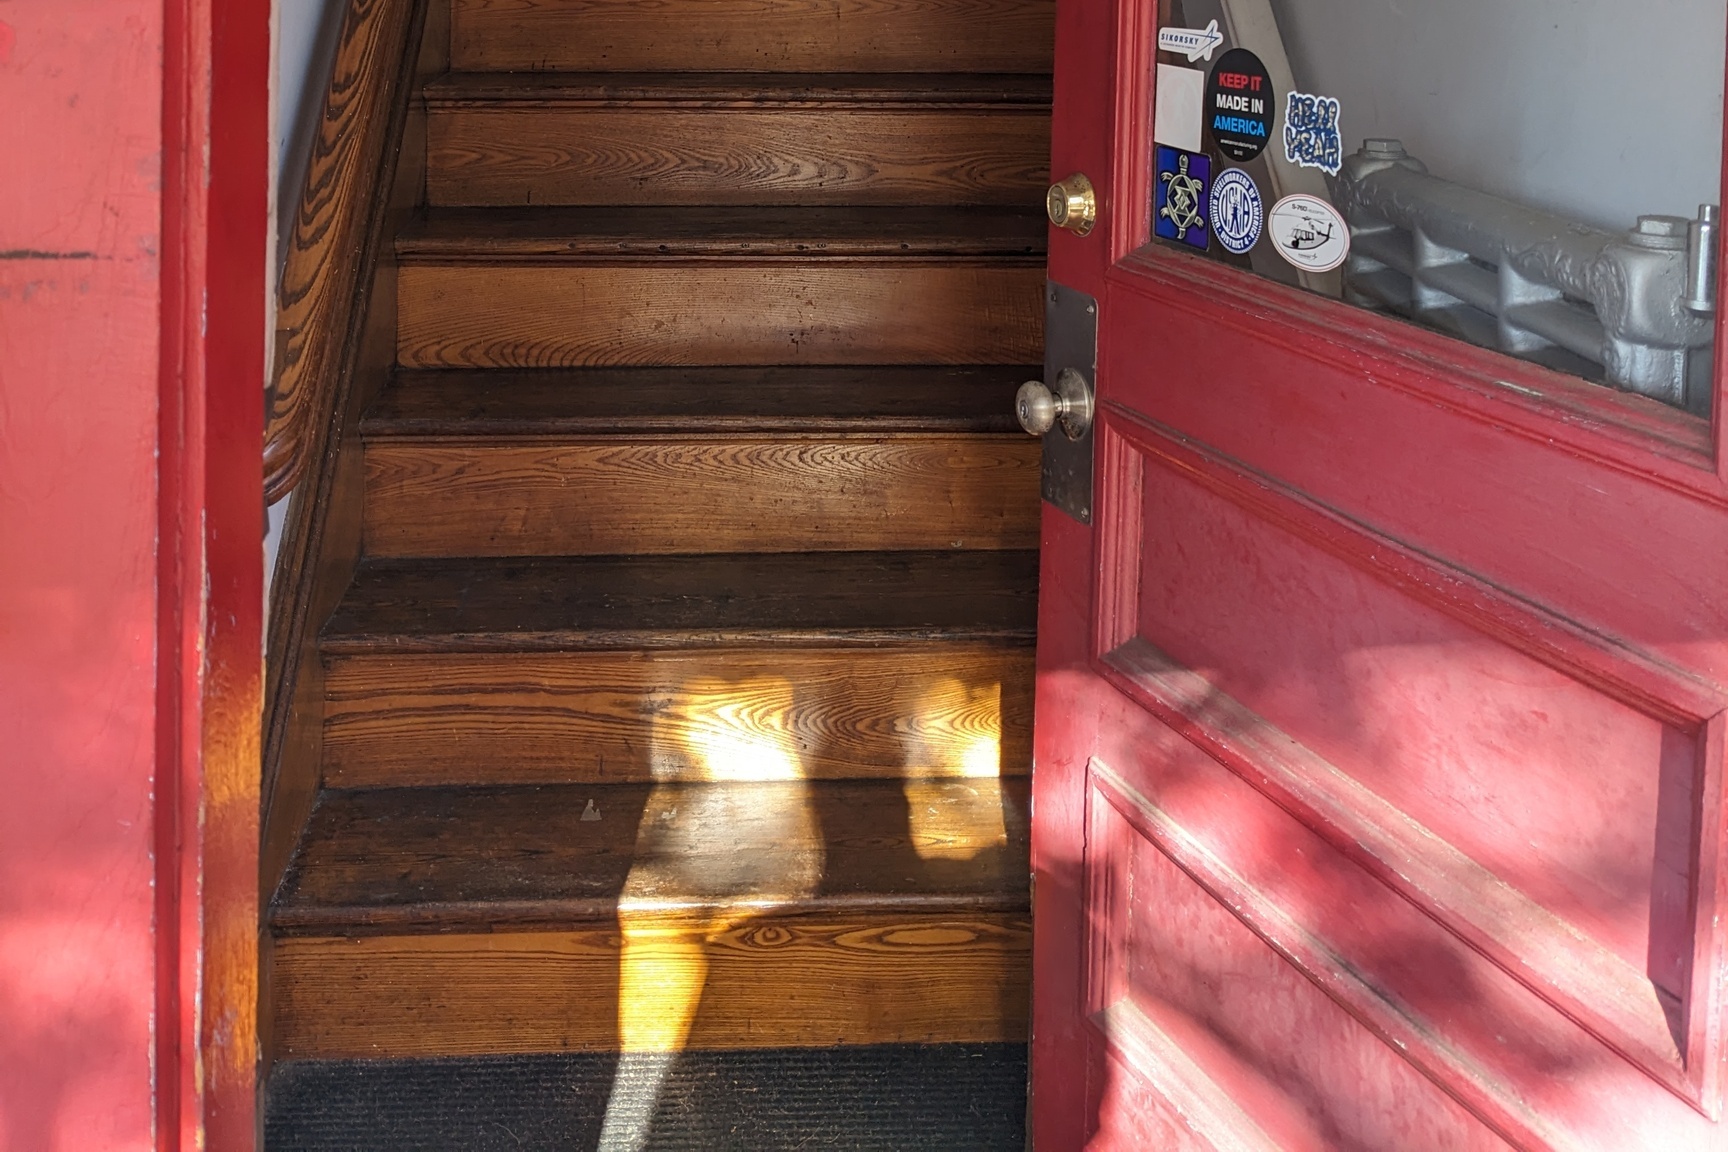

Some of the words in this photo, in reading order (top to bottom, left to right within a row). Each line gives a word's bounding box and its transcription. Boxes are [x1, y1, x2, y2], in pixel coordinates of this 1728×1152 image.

[1161, 33, 1199, 45] SIKORSKY
[1219, 73, 1248, 89] KEEP
[1250, 76, 1262, 91] IT
[1216, 93, 1249, 112] MADE
[1251, 98, 1263, 114] IN
[1213, 114, 1266, 137] AMERICA
[1213, 172, 1249, 198] STEELWORKERS
[1248, 188, 1256, 199] OF
[1212, 199, 1220, 228] UNITED
[1248, 200, 1260, 239] AMERICA
[1220, 231, 1244, 248] DISTRICT
